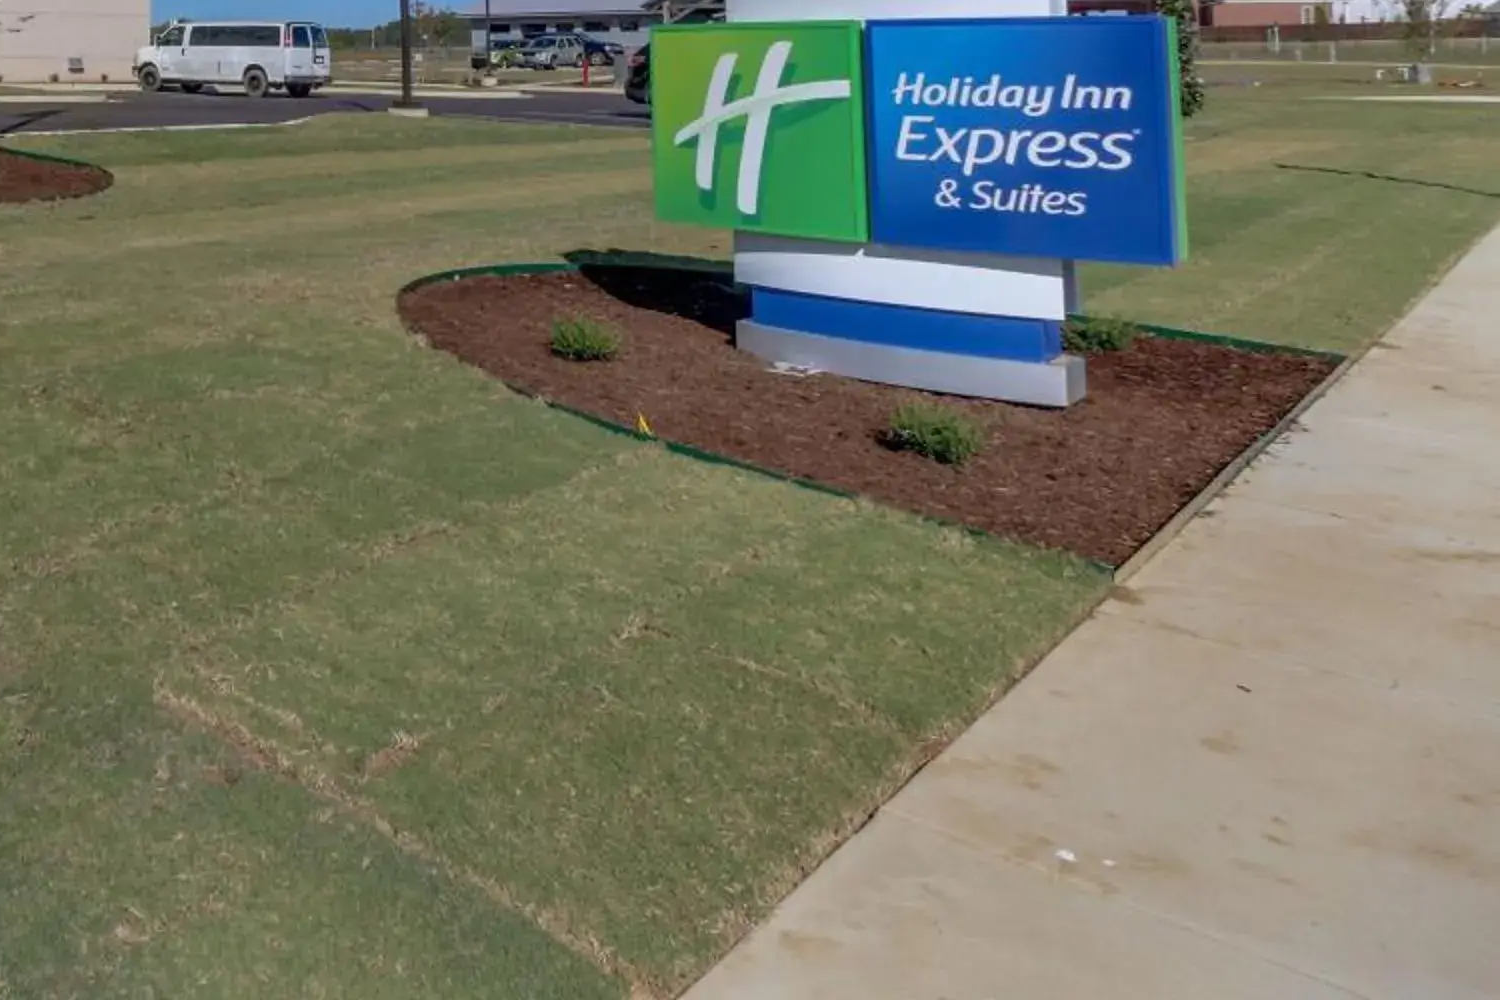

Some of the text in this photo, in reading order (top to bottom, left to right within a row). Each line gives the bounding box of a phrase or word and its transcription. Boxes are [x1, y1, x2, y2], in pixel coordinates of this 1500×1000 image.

[893, 72, 1132, 117] Holiday Inn
[895, 115, 1135, 176] Express
[935, 180, 1087, 216] & Suites
